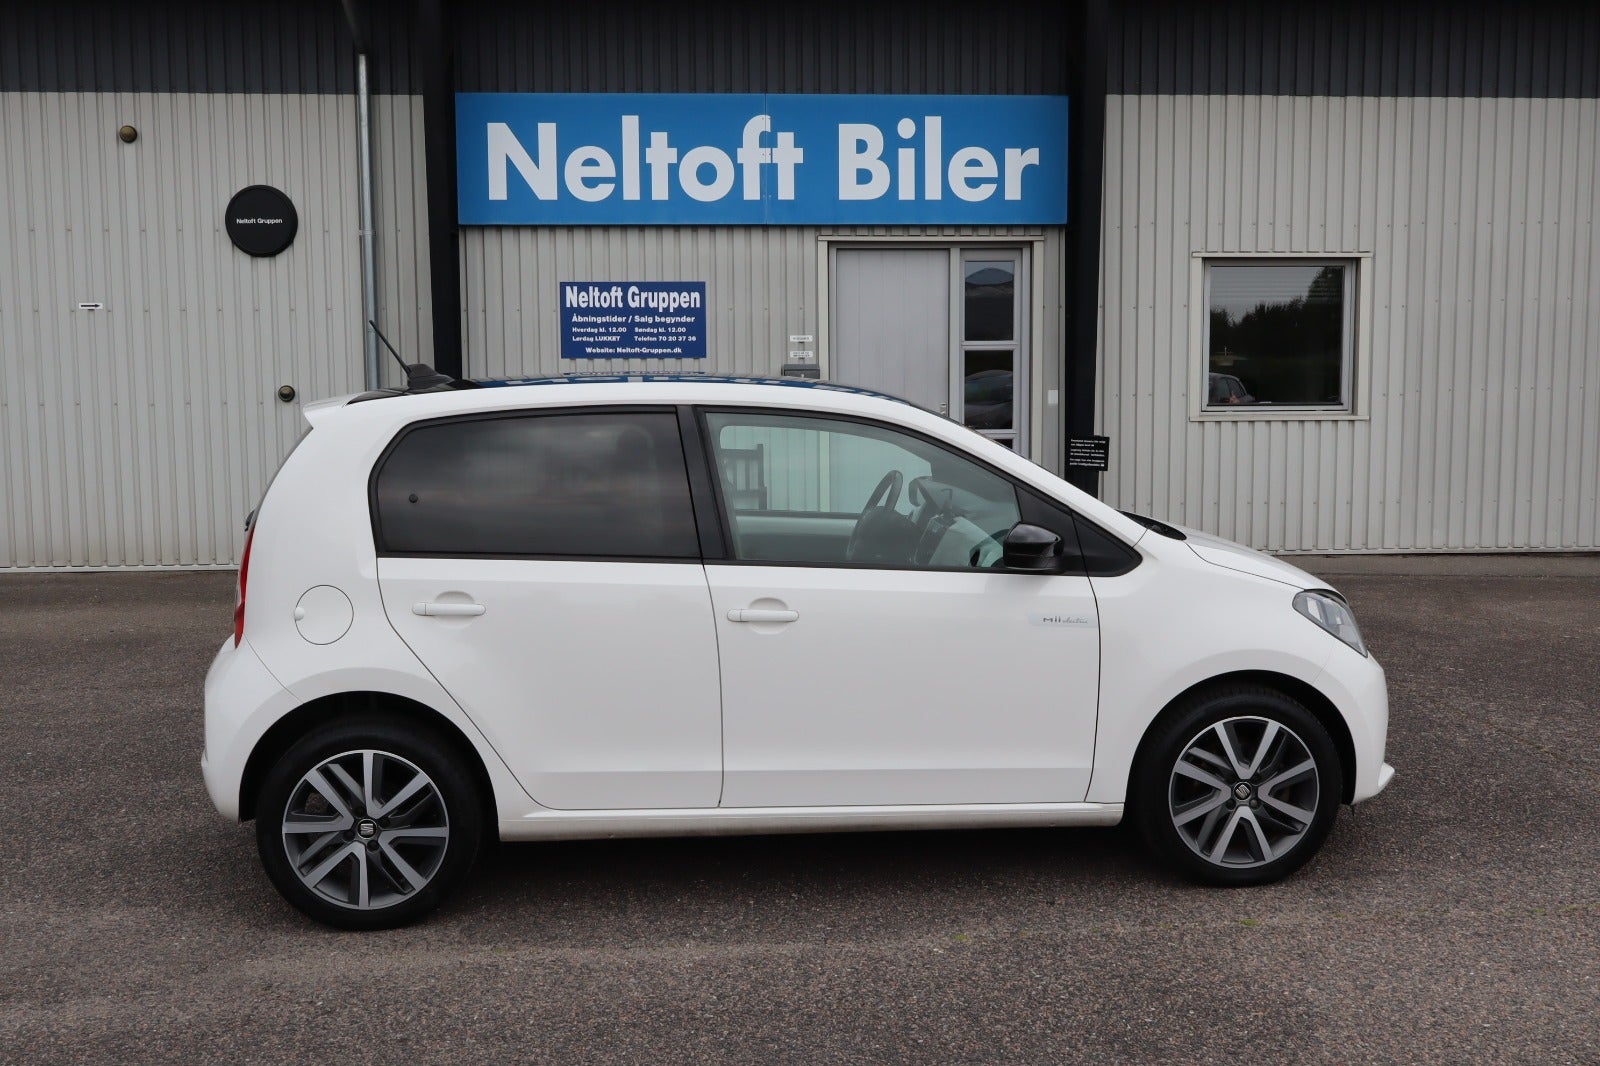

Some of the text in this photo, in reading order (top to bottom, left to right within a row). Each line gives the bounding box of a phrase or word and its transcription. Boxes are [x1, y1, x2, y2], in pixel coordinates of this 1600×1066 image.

[487, 114, 1040, 202] Neltoft Biler
[566, 286, 700, 312] Neltoft Gruppen
[572, 313, 627, 323] Åbningstider
[634, 315, 653, 323] Salg
[655, 315, 695, 323] begynder
